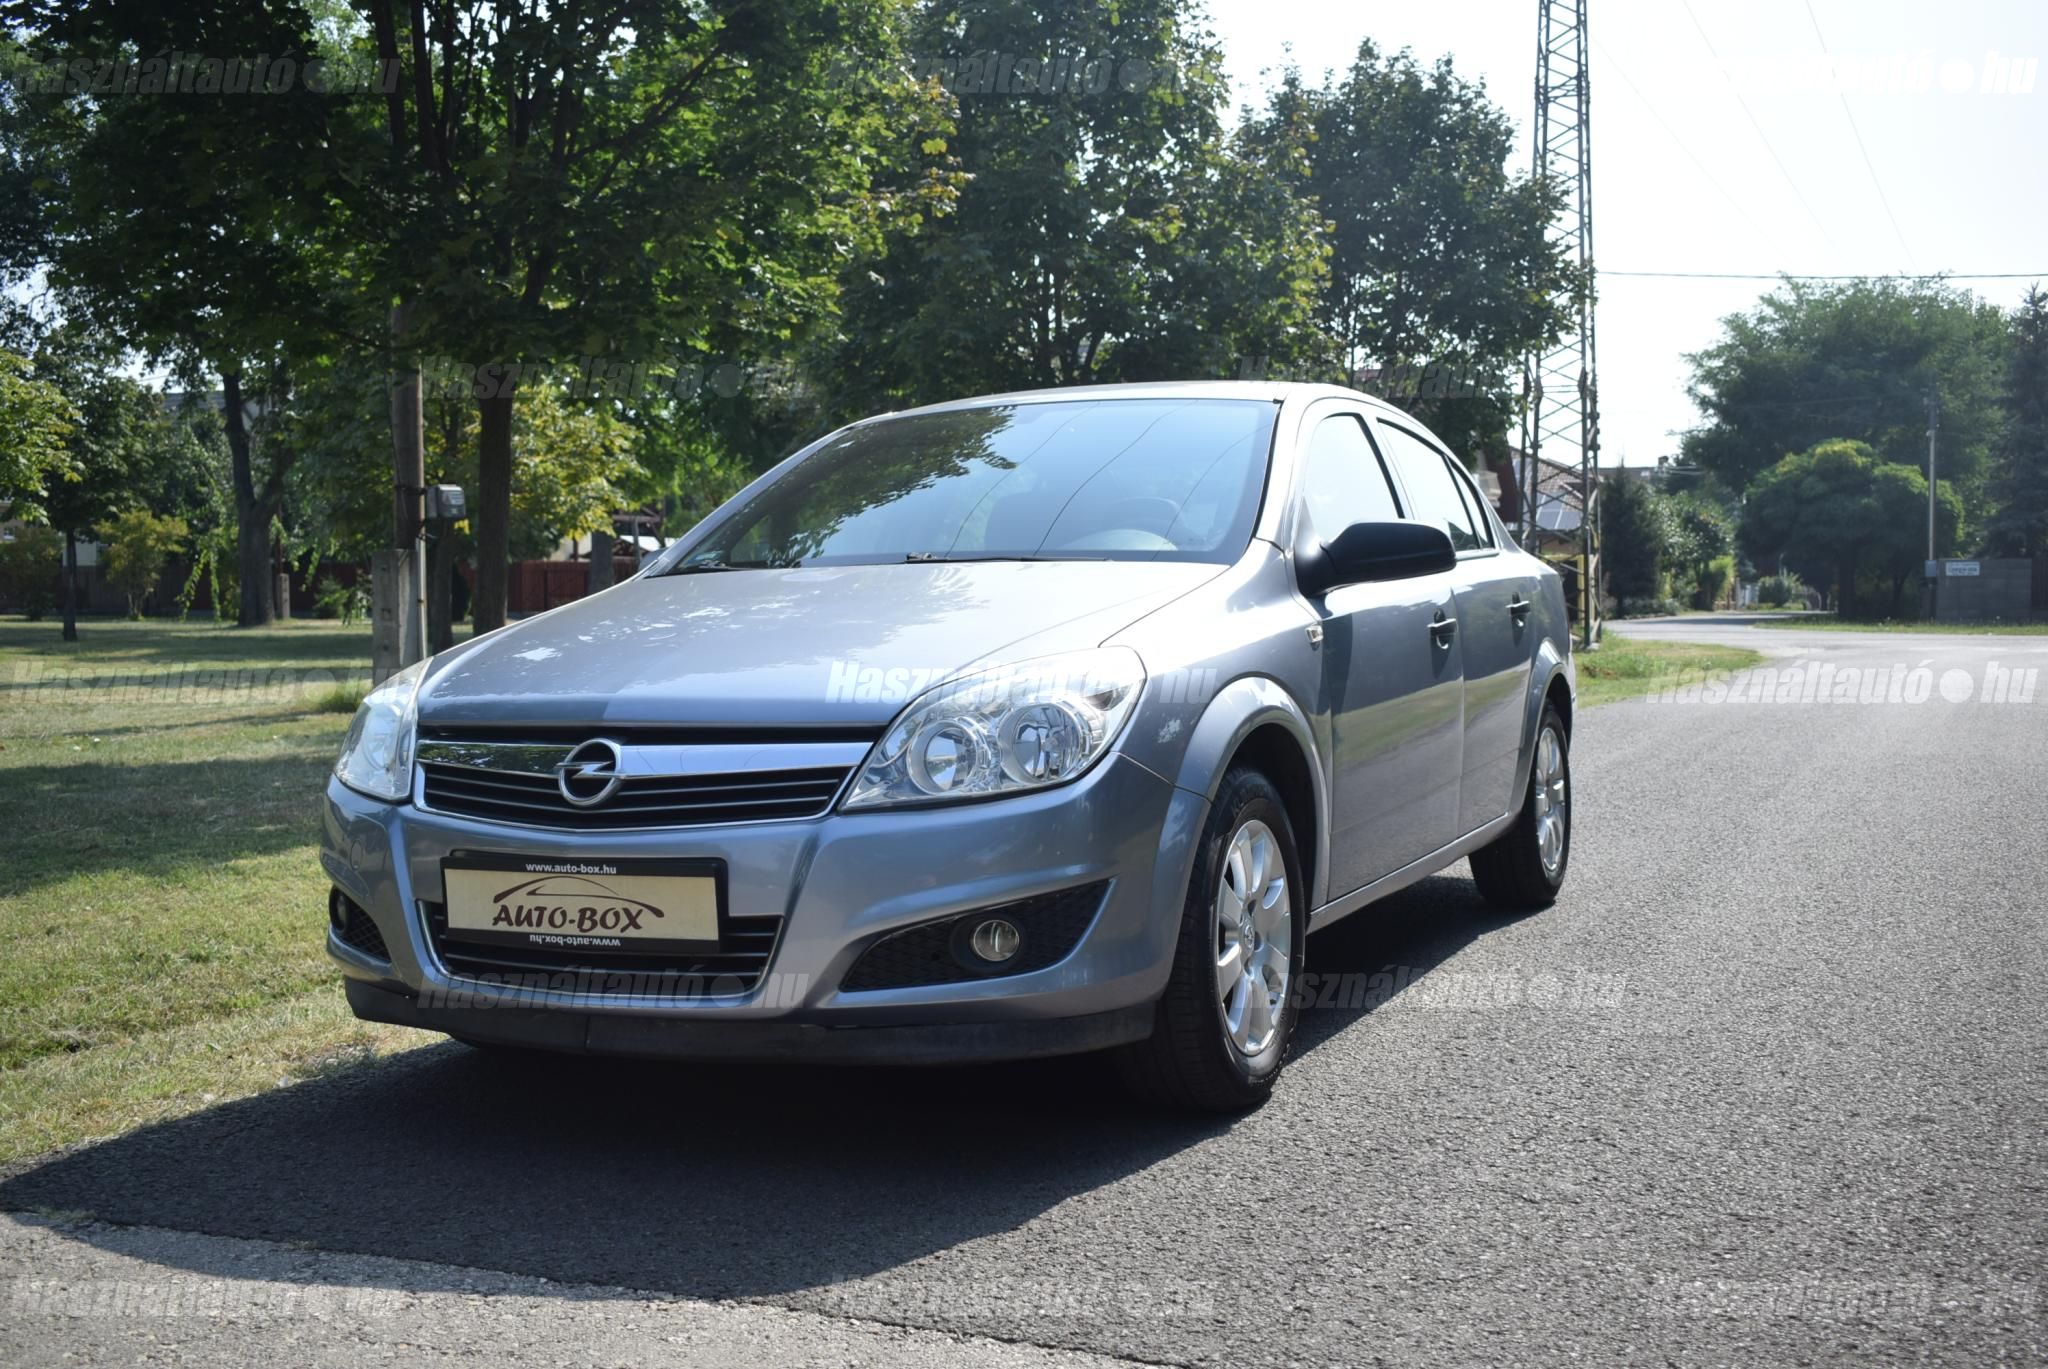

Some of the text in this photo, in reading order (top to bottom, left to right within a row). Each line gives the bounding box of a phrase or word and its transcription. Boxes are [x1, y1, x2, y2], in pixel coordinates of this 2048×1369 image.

[525, 862, 617, 875] www.auto-box.hu
[492, 904, 643, 933] AUTO-BOX
[529, 934, 621, 947] www.auto-box.hu
